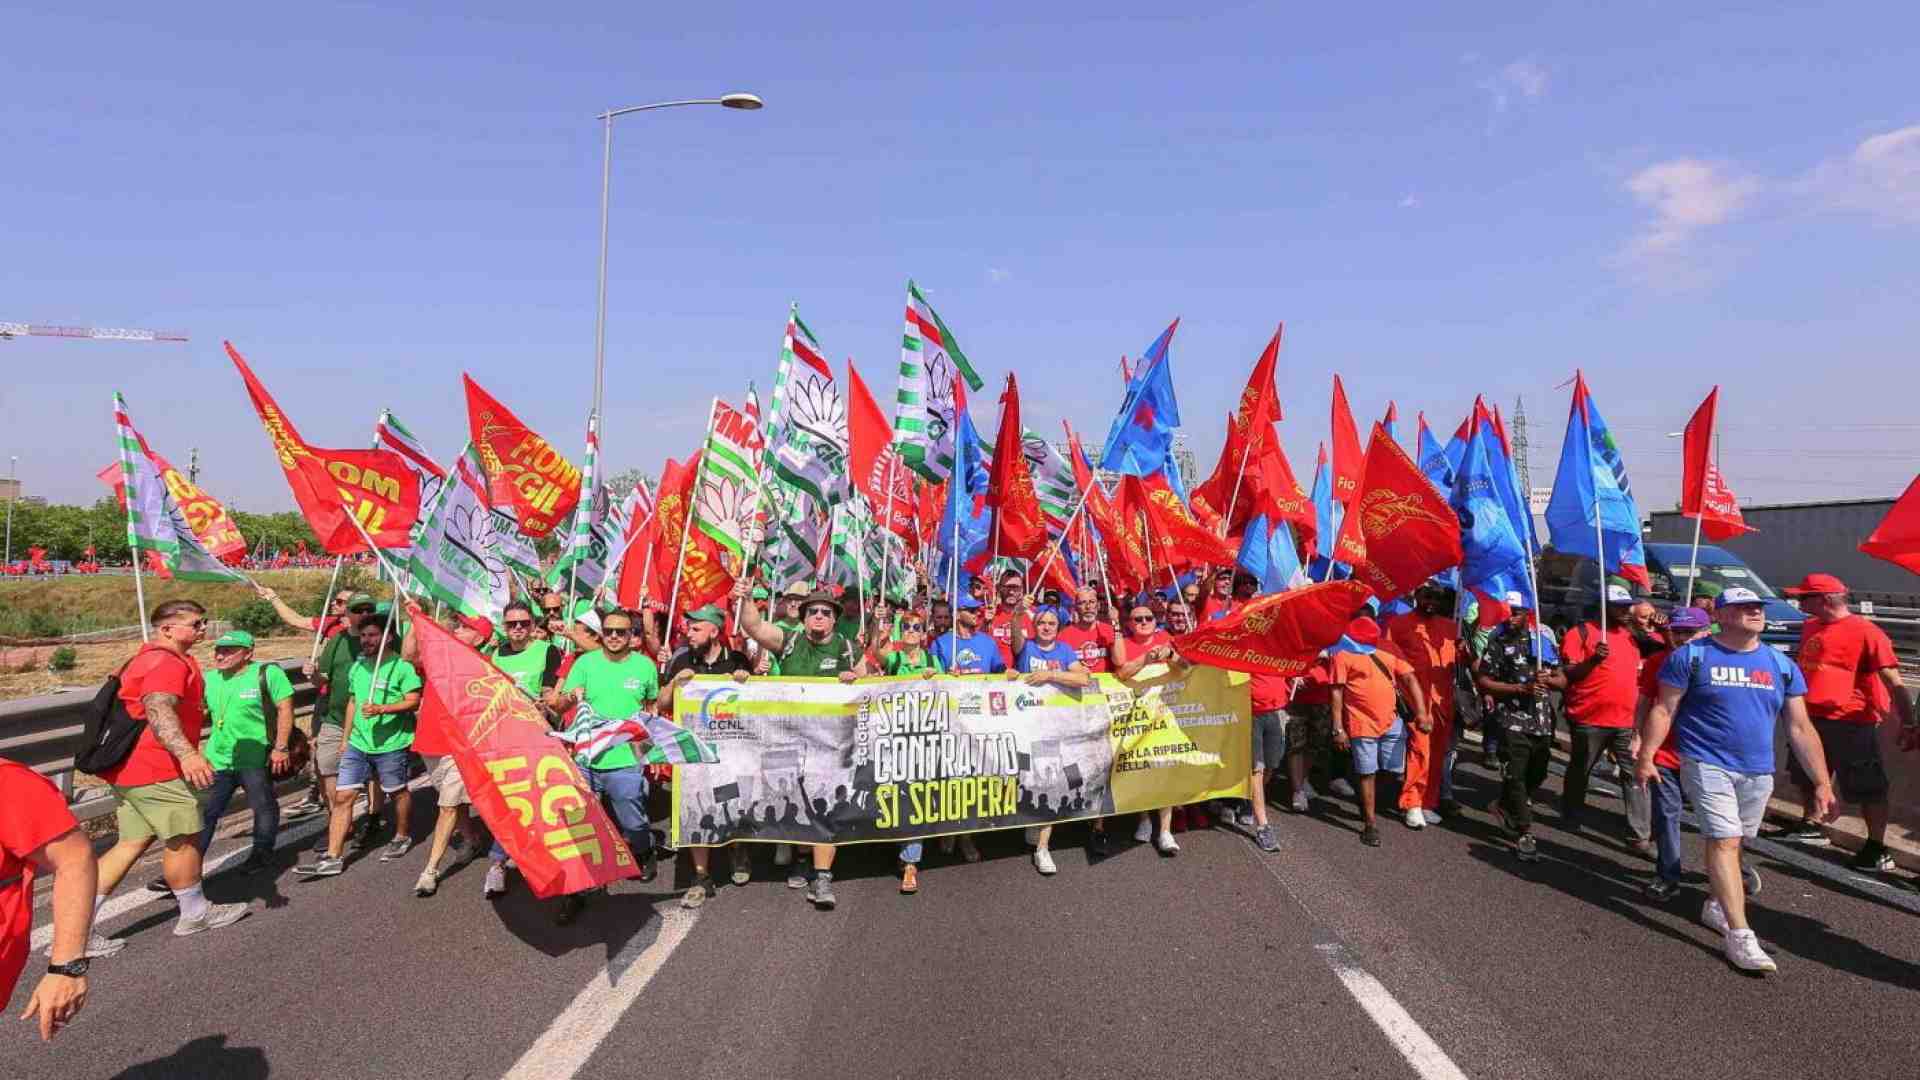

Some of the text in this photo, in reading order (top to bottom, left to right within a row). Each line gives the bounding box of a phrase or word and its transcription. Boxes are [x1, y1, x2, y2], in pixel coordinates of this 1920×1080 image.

[327, 461, 400, 504] OM
[510, 433, 581, 491] FIOM
[1198, 640, 1307, 672] Emilia Romagna
[1711, 666, 1772, 686] UILM
[708, 720, 744, 730] CCNL
[875, 691, 950, 735] SENZA
[874, 732, 1019, 784] CONTRATTO
[1118, 741, 1200, 762] PER LA RIPRESA
[874, 776, 1017, 829] SI SCIOPERA
